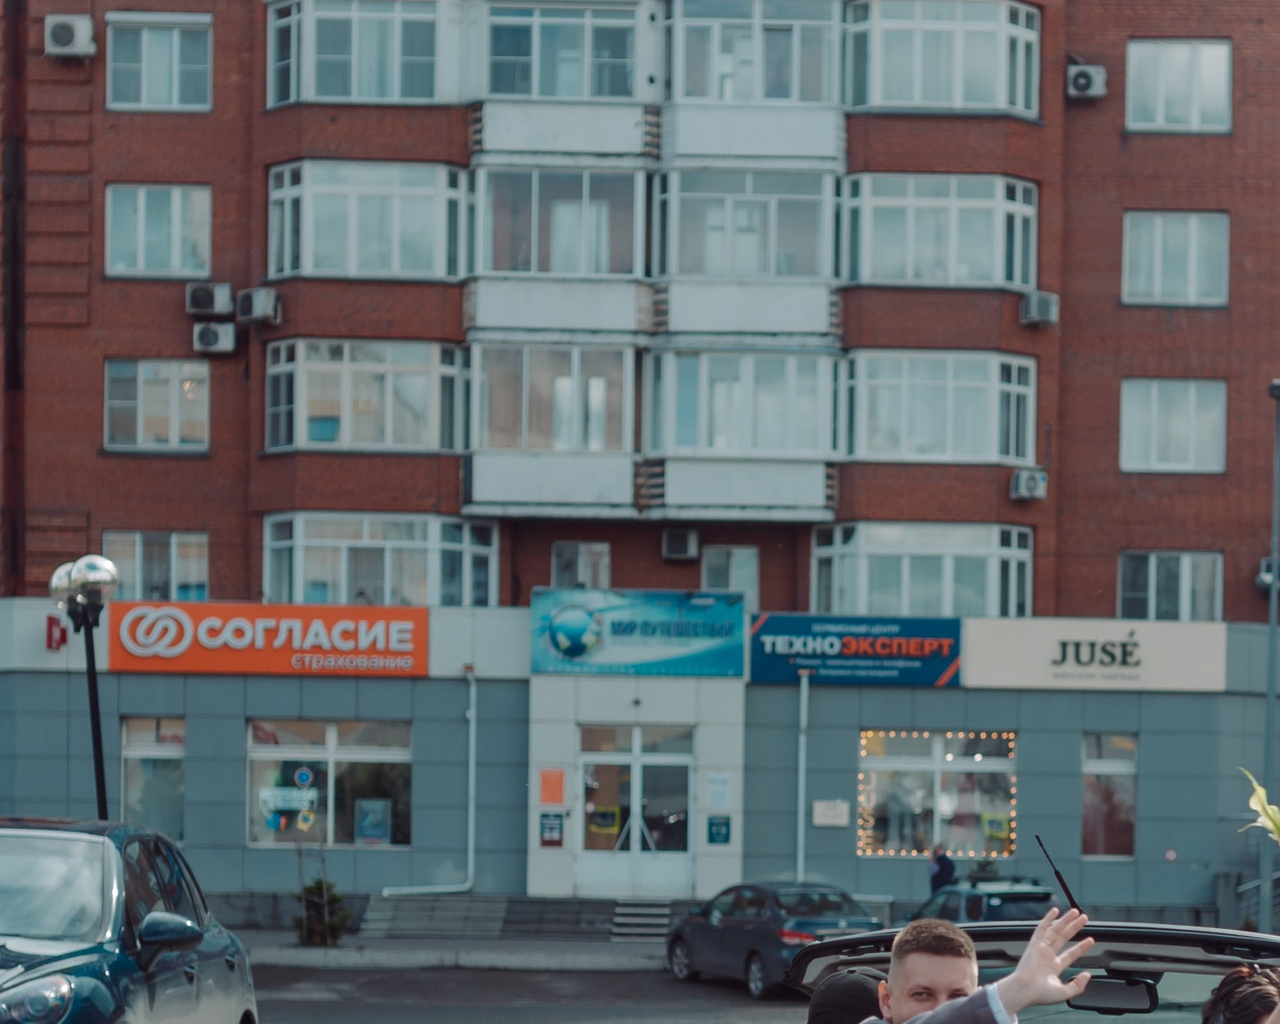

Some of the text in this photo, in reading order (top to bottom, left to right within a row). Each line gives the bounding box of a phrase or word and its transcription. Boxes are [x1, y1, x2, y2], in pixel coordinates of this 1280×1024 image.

[196, 616, 415, 652] СОГЛАСИЕ
[760, 635, 954, 657] ТЕХНОЭКСПЕРТ
[1051, 629, 1142, 667] JUSÉ
[291, 653, 414, 671] страхование
